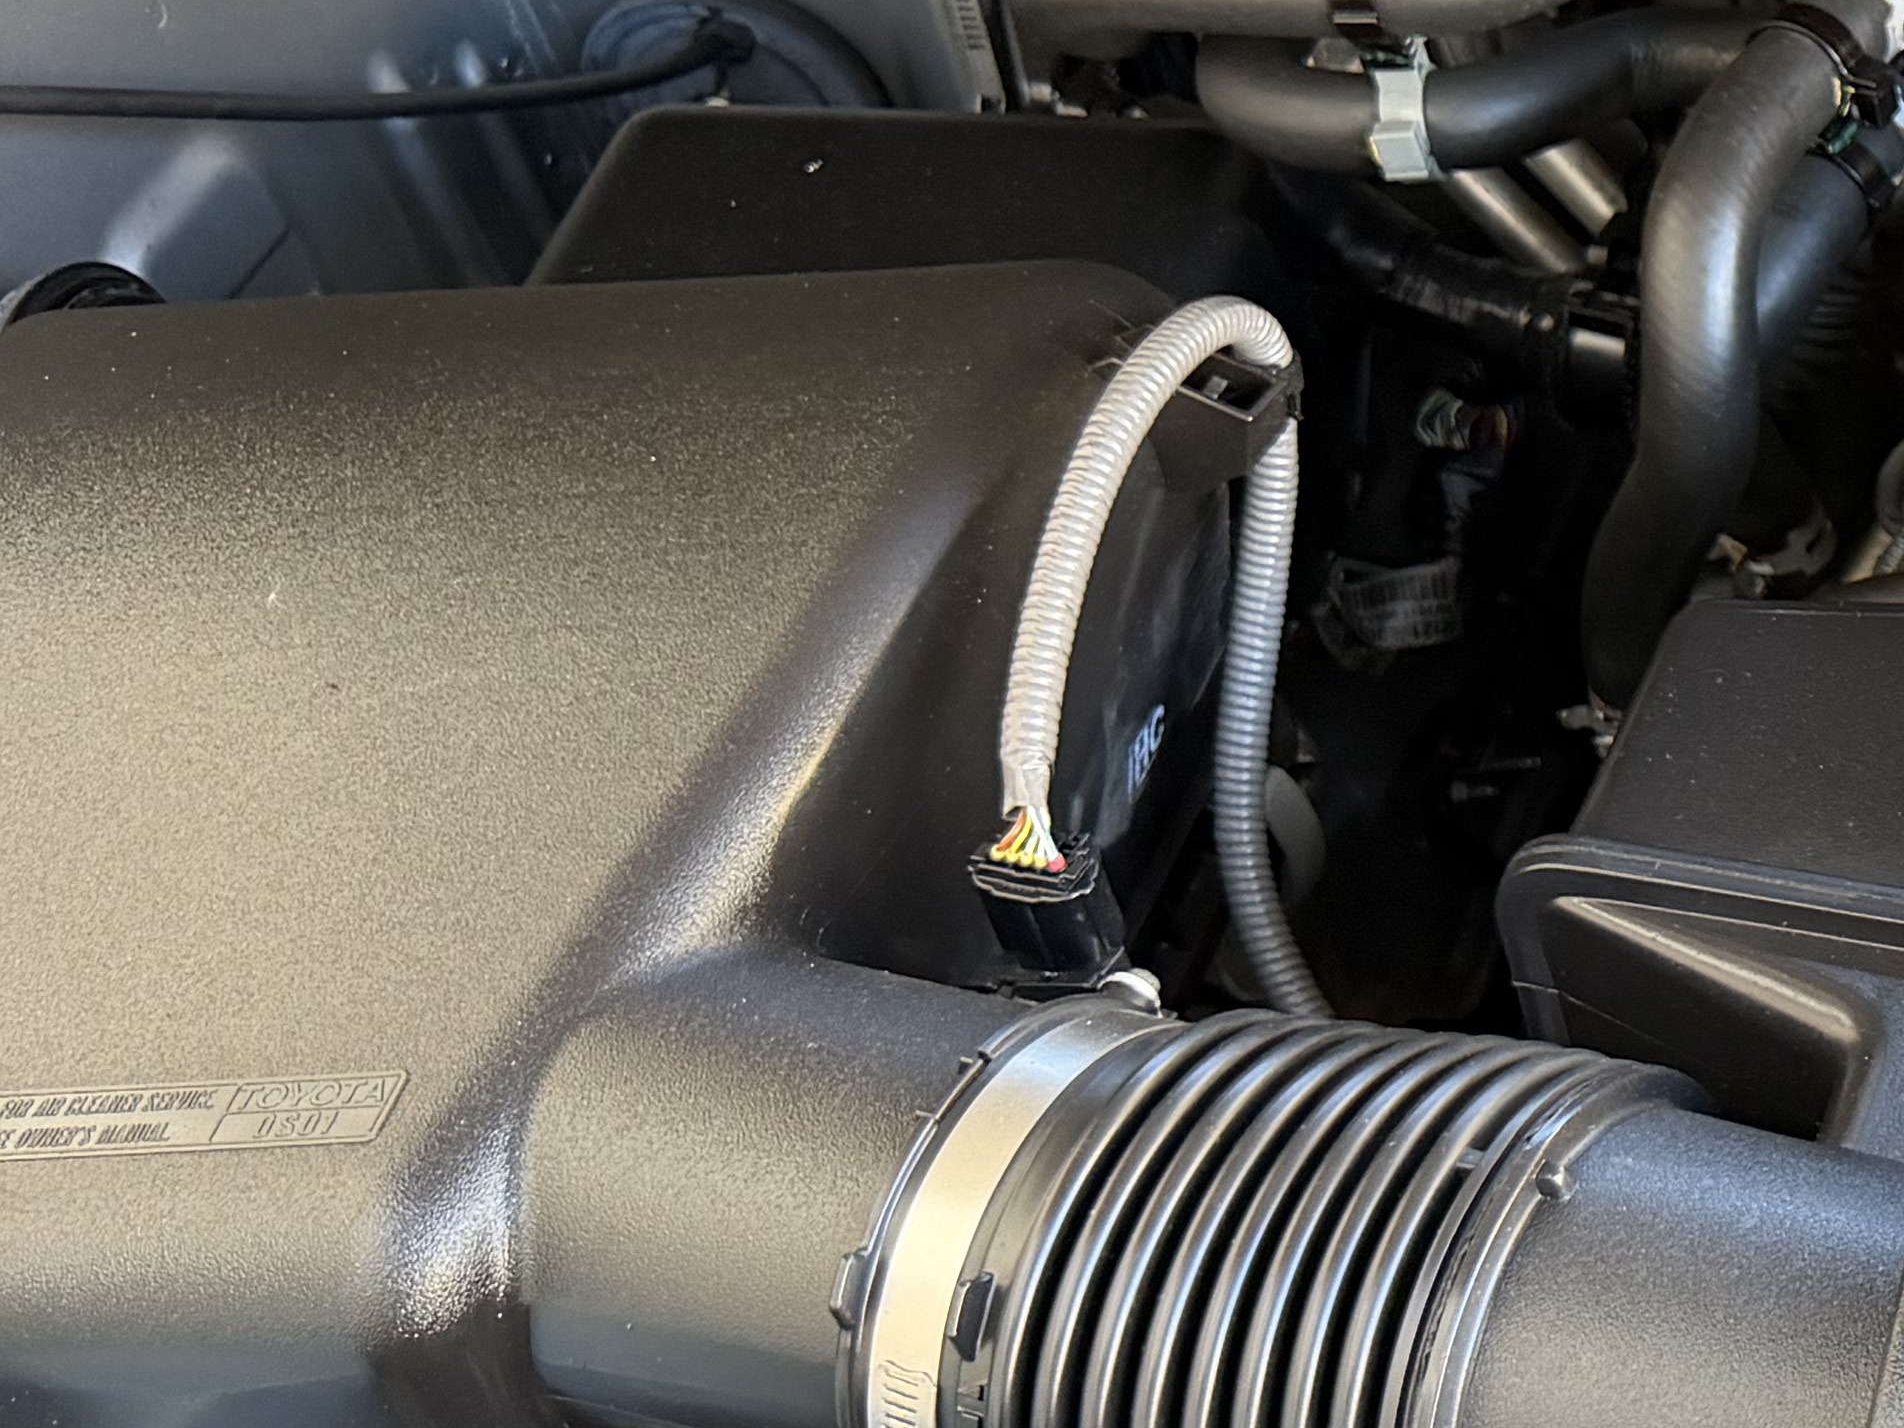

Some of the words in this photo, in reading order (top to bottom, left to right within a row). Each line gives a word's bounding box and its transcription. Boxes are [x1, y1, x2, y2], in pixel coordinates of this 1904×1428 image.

[33, 1096, 62, 1117] AIR
[64, 1093, 142, 1117] CLEANER
[143, 1089, 220, 1113] SERVICE
[241, 1078, 387, 1109] TOYOTA
[17, 1123, 96, 1149] OWNER'S
[98, 1121, 171, 1146] MANUAL
